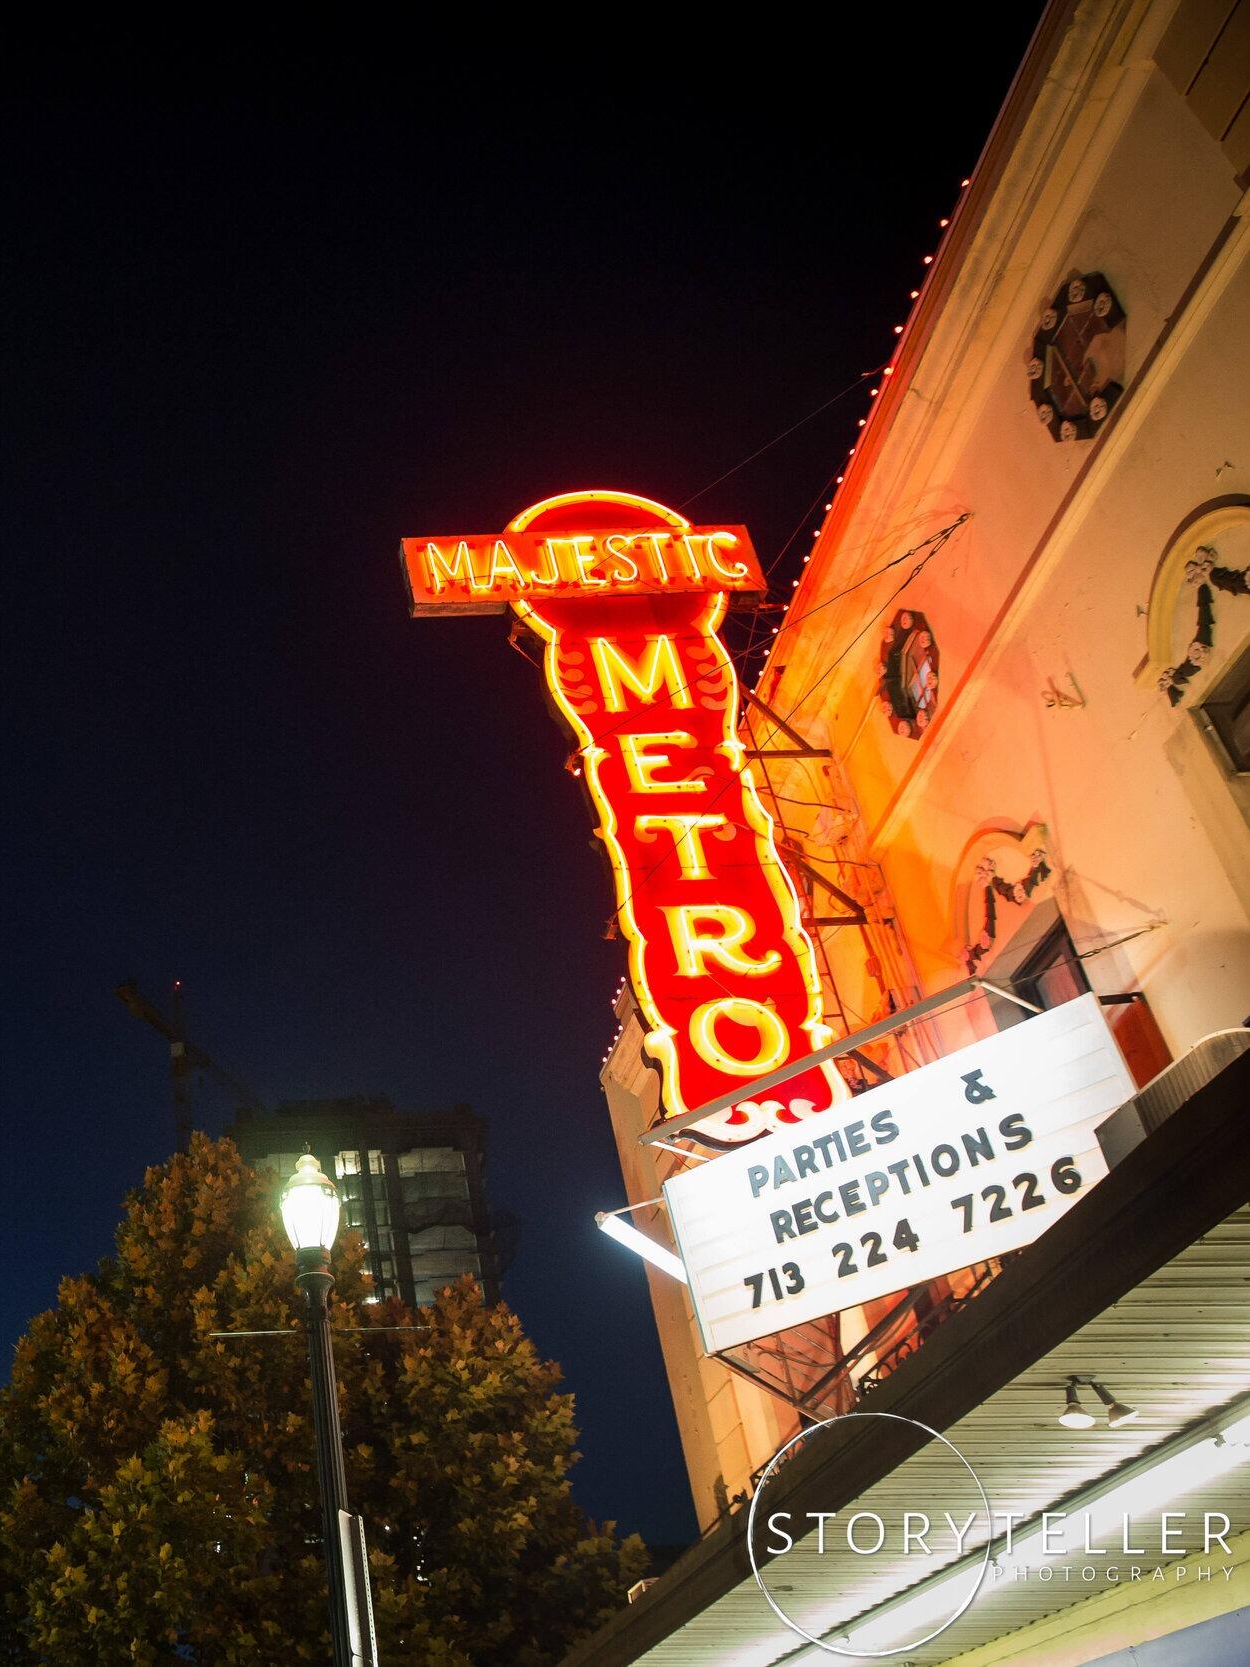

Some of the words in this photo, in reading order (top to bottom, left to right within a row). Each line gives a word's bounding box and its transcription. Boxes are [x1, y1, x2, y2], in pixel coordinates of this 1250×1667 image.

[419, 531, 749, 592] MAJESTIC
[586, 633, 791, 1076] METRO
[747, 1109, 900, 1198] PARTIES
[960, 1068, 997, 1105] &
[769, 1113, 1033, 1244] RECEPTIONS
[744, 1262, 806, 1310] 713
[831, 1218, 921, 1279] 224
[951, 1156, 1082, 1234] 7226
